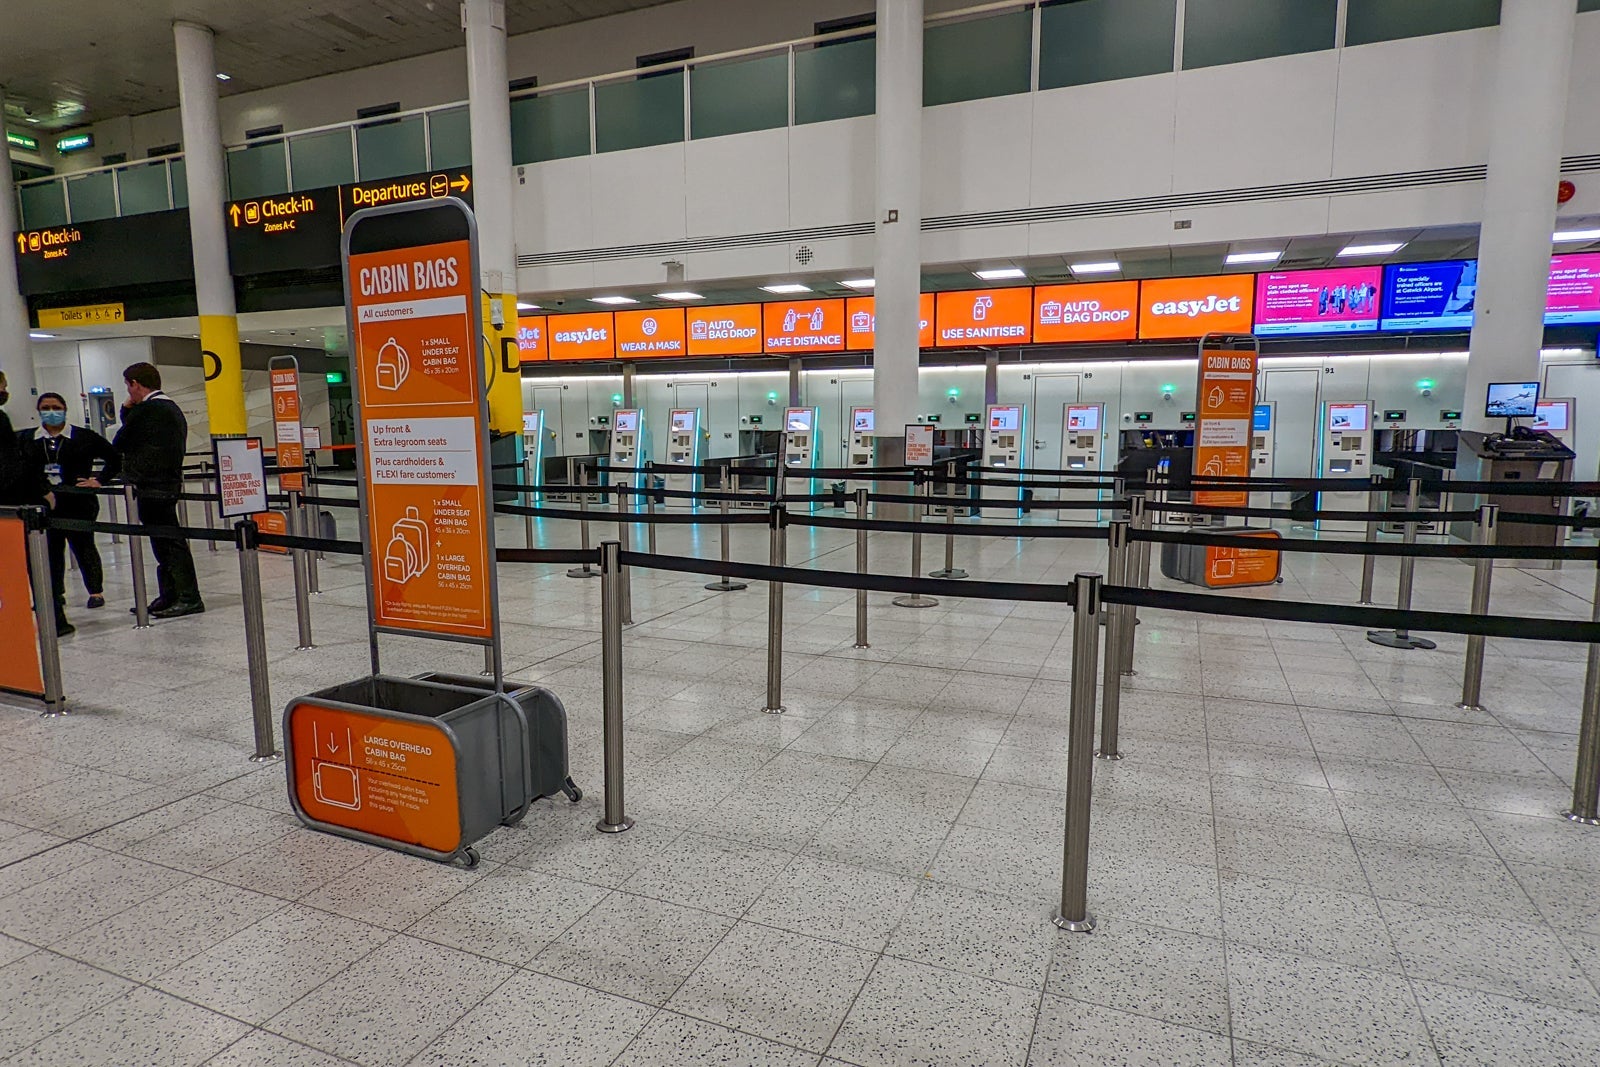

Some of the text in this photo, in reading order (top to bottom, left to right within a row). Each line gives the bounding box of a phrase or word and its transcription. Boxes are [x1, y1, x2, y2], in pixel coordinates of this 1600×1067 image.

[353, 181, 426, 206] Departures
[262, 196, 314, 218] Check-in
[264, 220, 296, 232] Zones A-C
[42, 228, 81, 245] Check-in
[44, 250, 58, 258] Zones
[360, 257, 458, 296] CABIN BAGS
[1064, 301, 1100, 312] AUTO
[1152, 296, 1240, 317] easyJet
[60, 311, 82, 320] Toilets
[364, 307, 414, 319] All customers
[1064, 310, 1129, 323] BAG DROP
[708, 320, 734, 329] AUTO
[556, 328, 607, 343] easyJet
[708, 329, 756, 339] BAG DROP
[942, 326, 1025, 339] USE SANITISER
[520, 341, 536, 350] plus
[621, 341, 680, 351] WEAR A MASK
[767, 336, 841, 347] SAFE DISTANCE
[501, 338, 520, 373] D
[1208, 356, 1251, 369] CABIN BAGS
[373, 425, 384, 434] Up
[386, 425, 404, 433] front
[374, 438, 393, 446] Extra
[394, 437, 426, 447] legroom
[376, 457, 444, 466] Plus cardholders &
[376, 470, 398, 478] FLEXI
[400, 469, 415, 478] fare
[223, 481, 247, 490] BOARDING
[224, 498, 244, 506] DETAILS
[364, 735, 432, 756] LARGE OVERHEAD
[365, 747, 406, 762] CABIN BAG
[391, 762, 406, 772] 25cm
